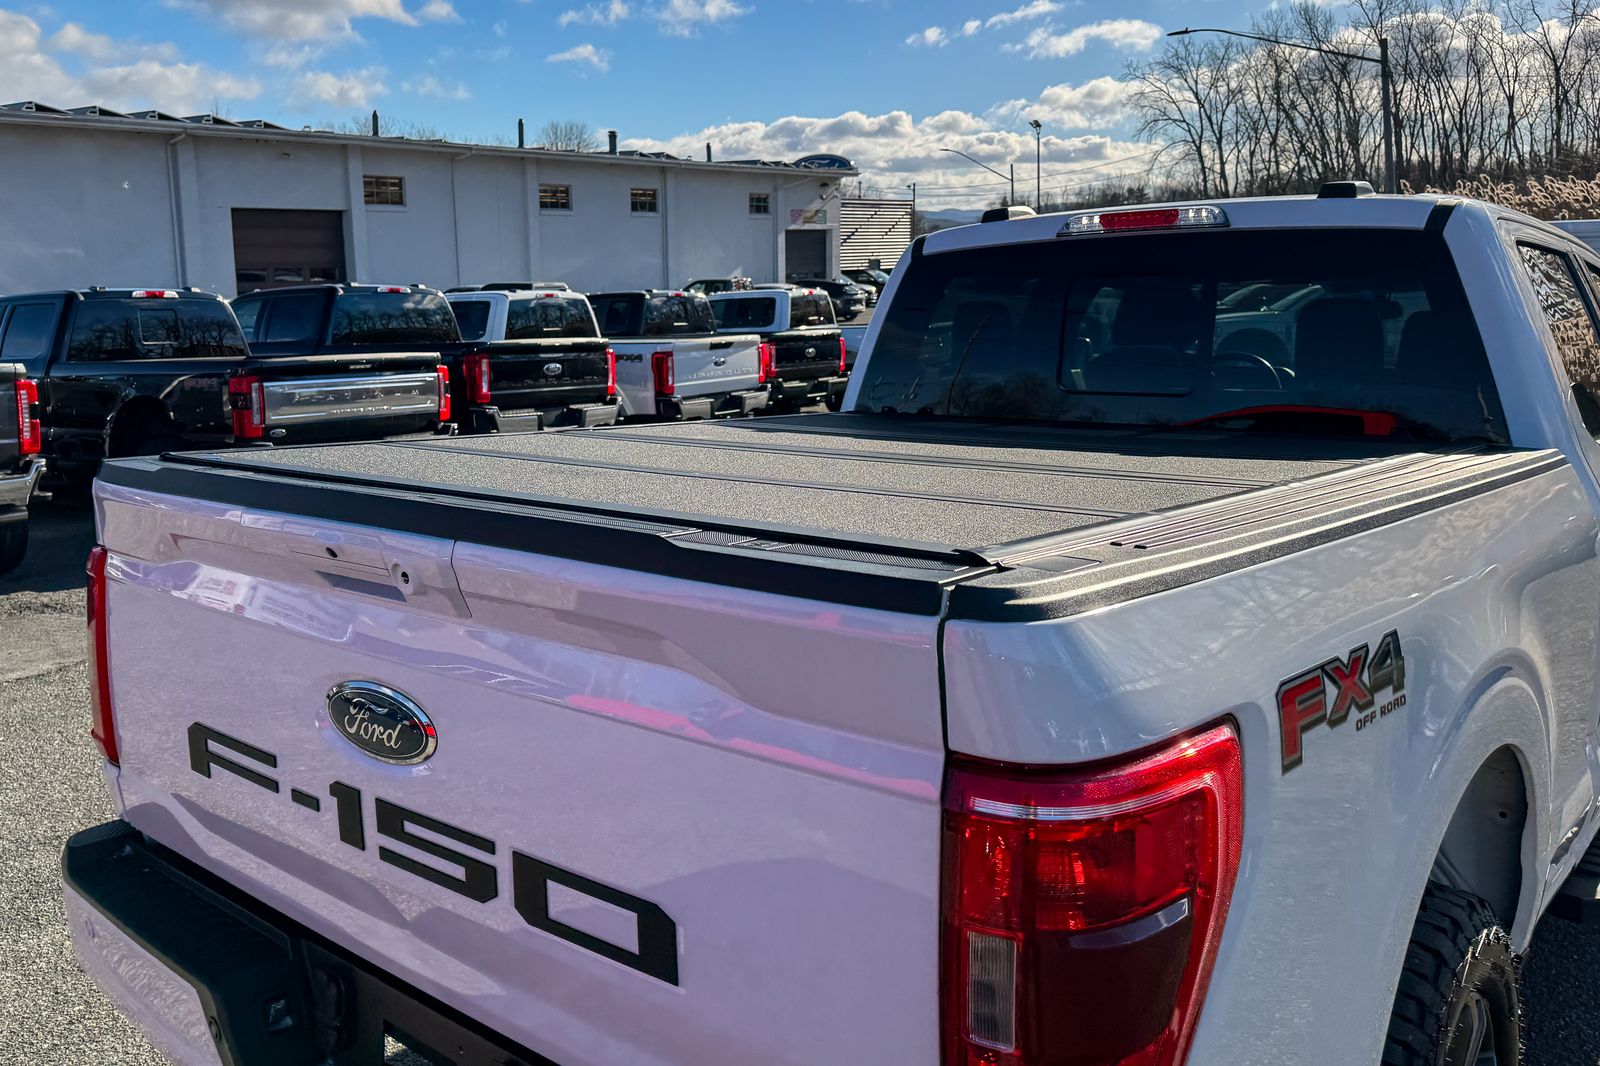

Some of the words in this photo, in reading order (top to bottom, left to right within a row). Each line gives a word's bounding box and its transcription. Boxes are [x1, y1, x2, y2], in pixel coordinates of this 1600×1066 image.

[343, 696, 402, 751] Ford
[1275, 628, 1406, 776] FX4
[1355, 712, 1377, 732] OFF
[1380, 693, 1407, 719] ROAD
[187, 721, 679, 987] F-150
